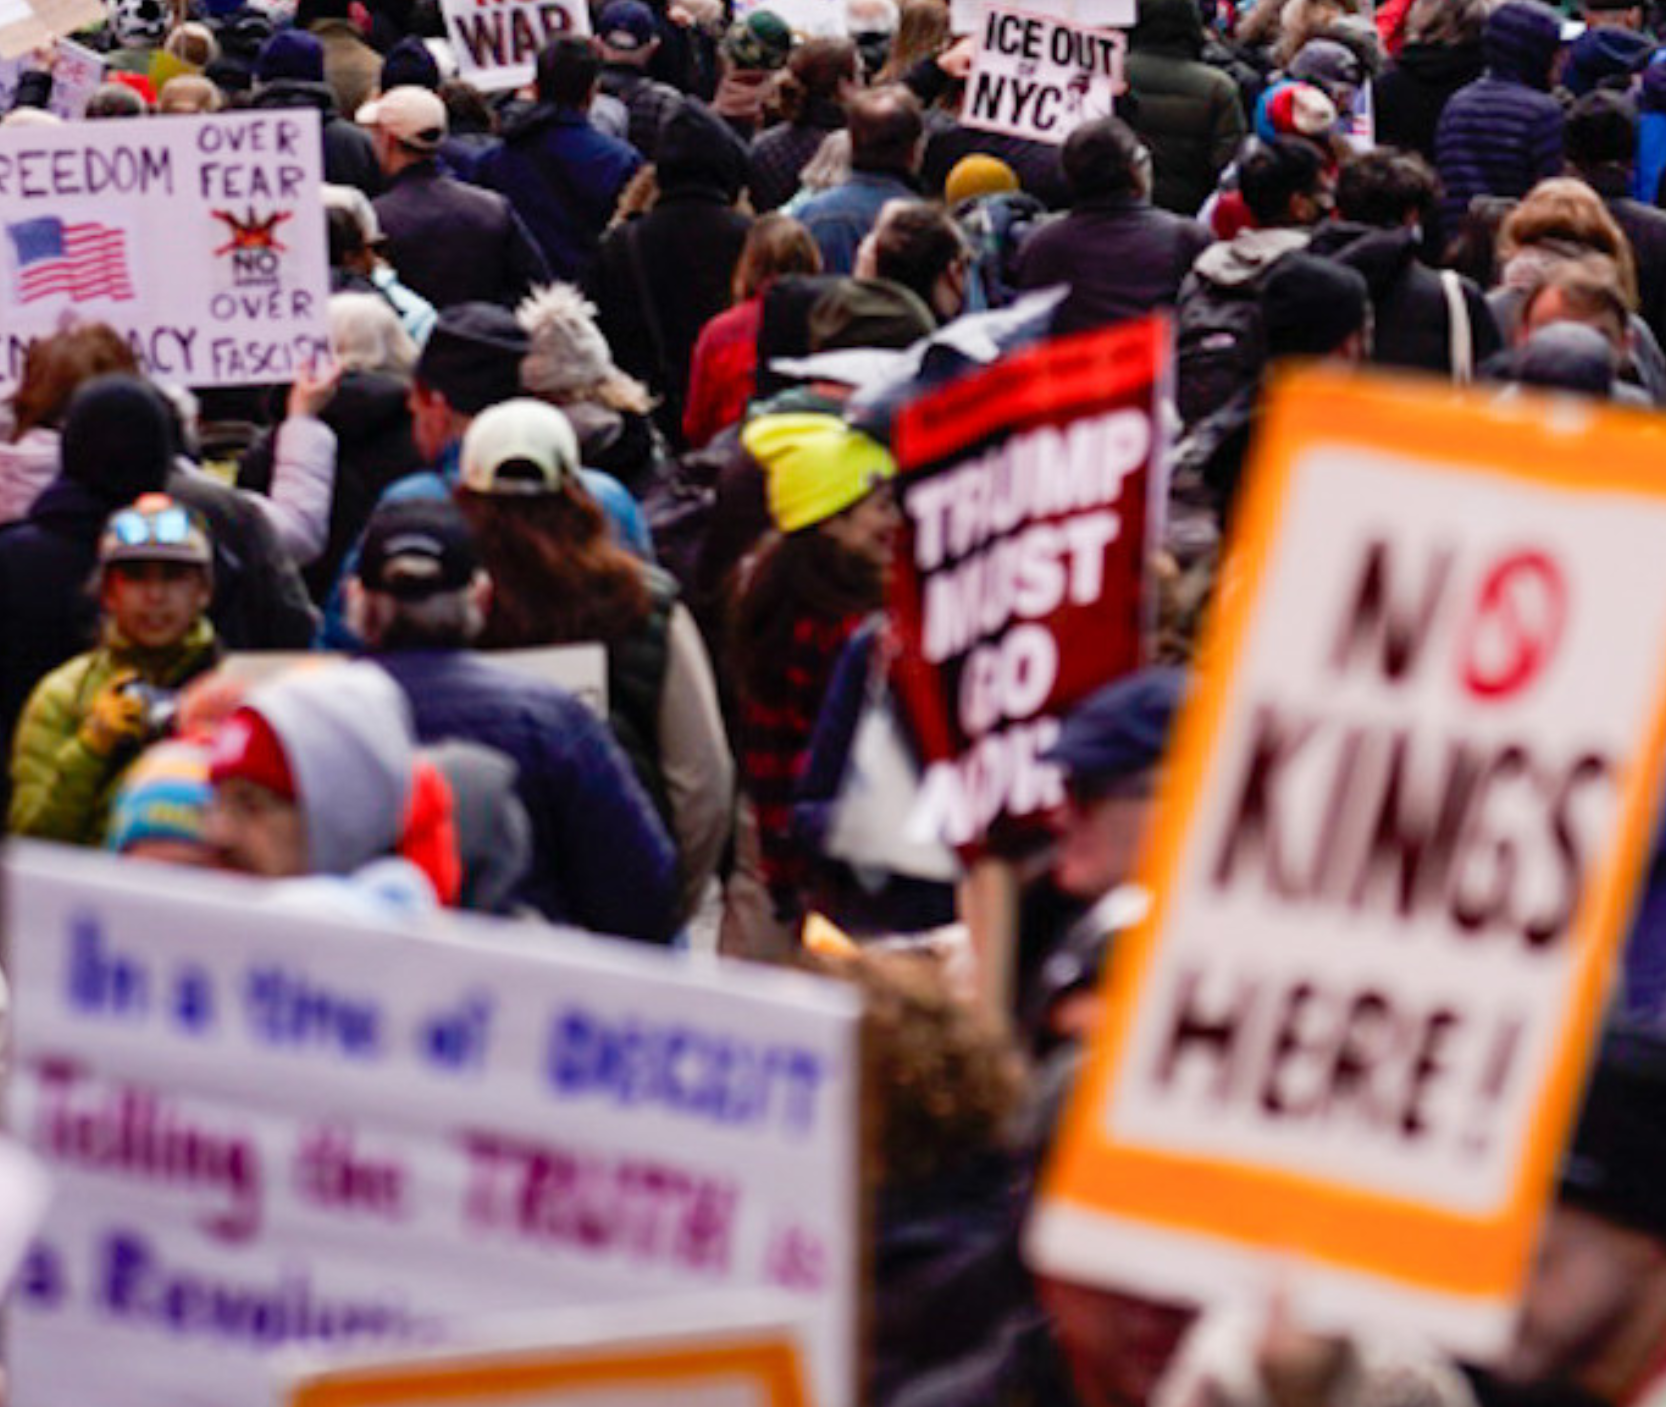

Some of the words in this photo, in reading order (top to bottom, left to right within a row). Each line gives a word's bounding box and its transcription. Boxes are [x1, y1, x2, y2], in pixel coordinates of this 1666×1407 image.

[453, 3, 574, 71] WAR
[983, 11, 1045, 61] ICE
[1050, 25, 1117, 77] OUT
[197, 120, 301, 157] OVER
[971, 73, 1062, 132] NYC
[199, 160, 307, 200] FEAR
[210, 289, 314, 321] OVER
[234, 250, 279, 275] NO
[210, 333, 332, 381] FASCISM
[904, 407, 1151, 571] TRUMP
[921, 510, 1121, 664] MUST
[1333, 538, 1573, 704] NO
[959, 622, 1058, 734] GO
[1211, 702, 1618, 950] KINGS
[67, 910, 146, 1020] In
[170, 964, 211, 1033] a
[239, 958, 381, 1063] time
[418, 990, 492, 1075] of
[545, 1008, 826, 1135] DECEIT
[1149, 966, 1523, 1162] HERE!
[23, 1056, 265, 1246] Telling
[295, 1116, 410, 1218] the
[457, 1124, 747, 1279] TRUTH
